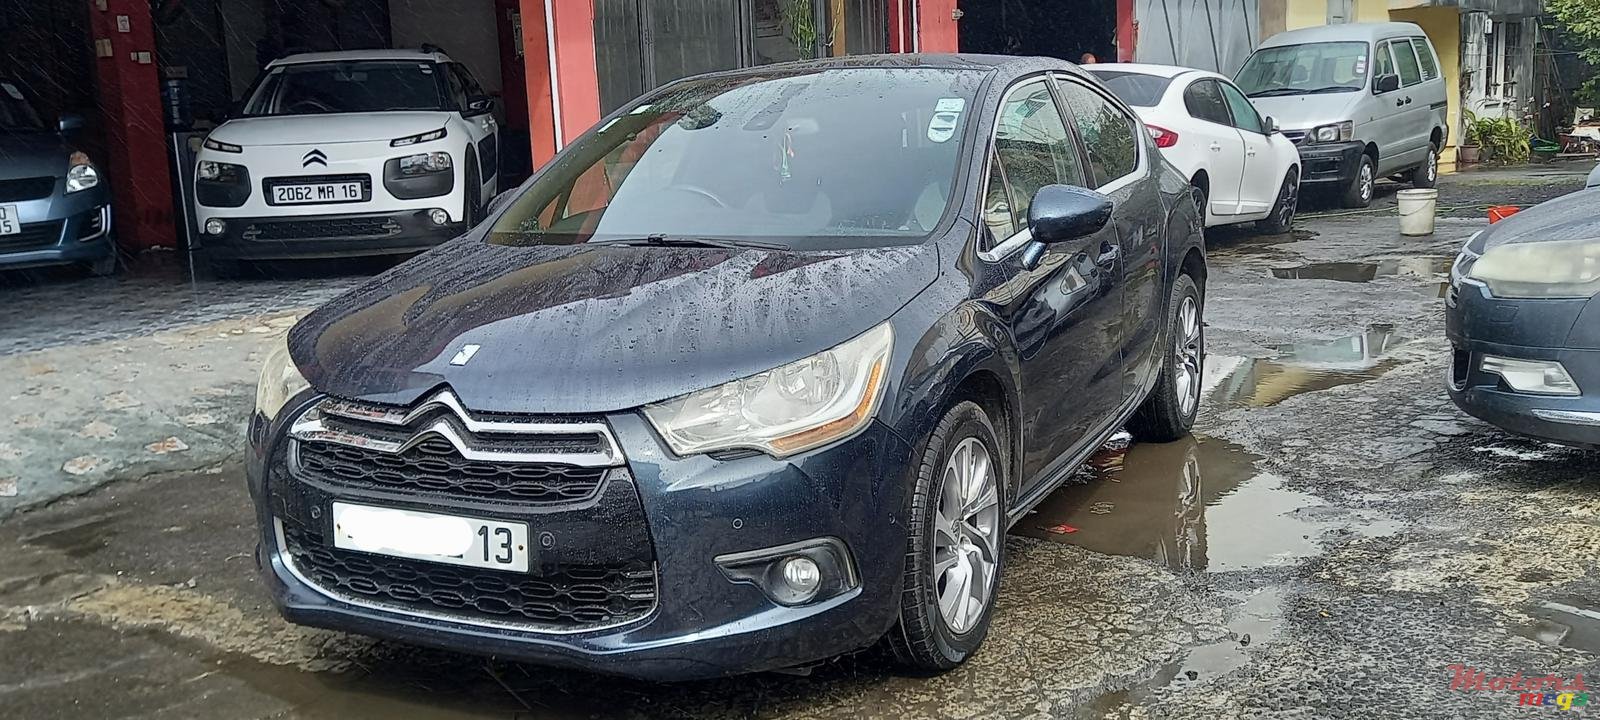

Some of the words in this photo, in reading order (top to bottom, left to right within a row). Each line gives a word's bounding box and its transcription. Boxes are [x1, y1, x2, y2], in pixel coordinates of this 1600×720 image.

[278, 187, 312, 201] 2062
[317, 185, 335, 200] MR
[342, 184, 357, 198] 16
[477, 525, 513, 564] 13
